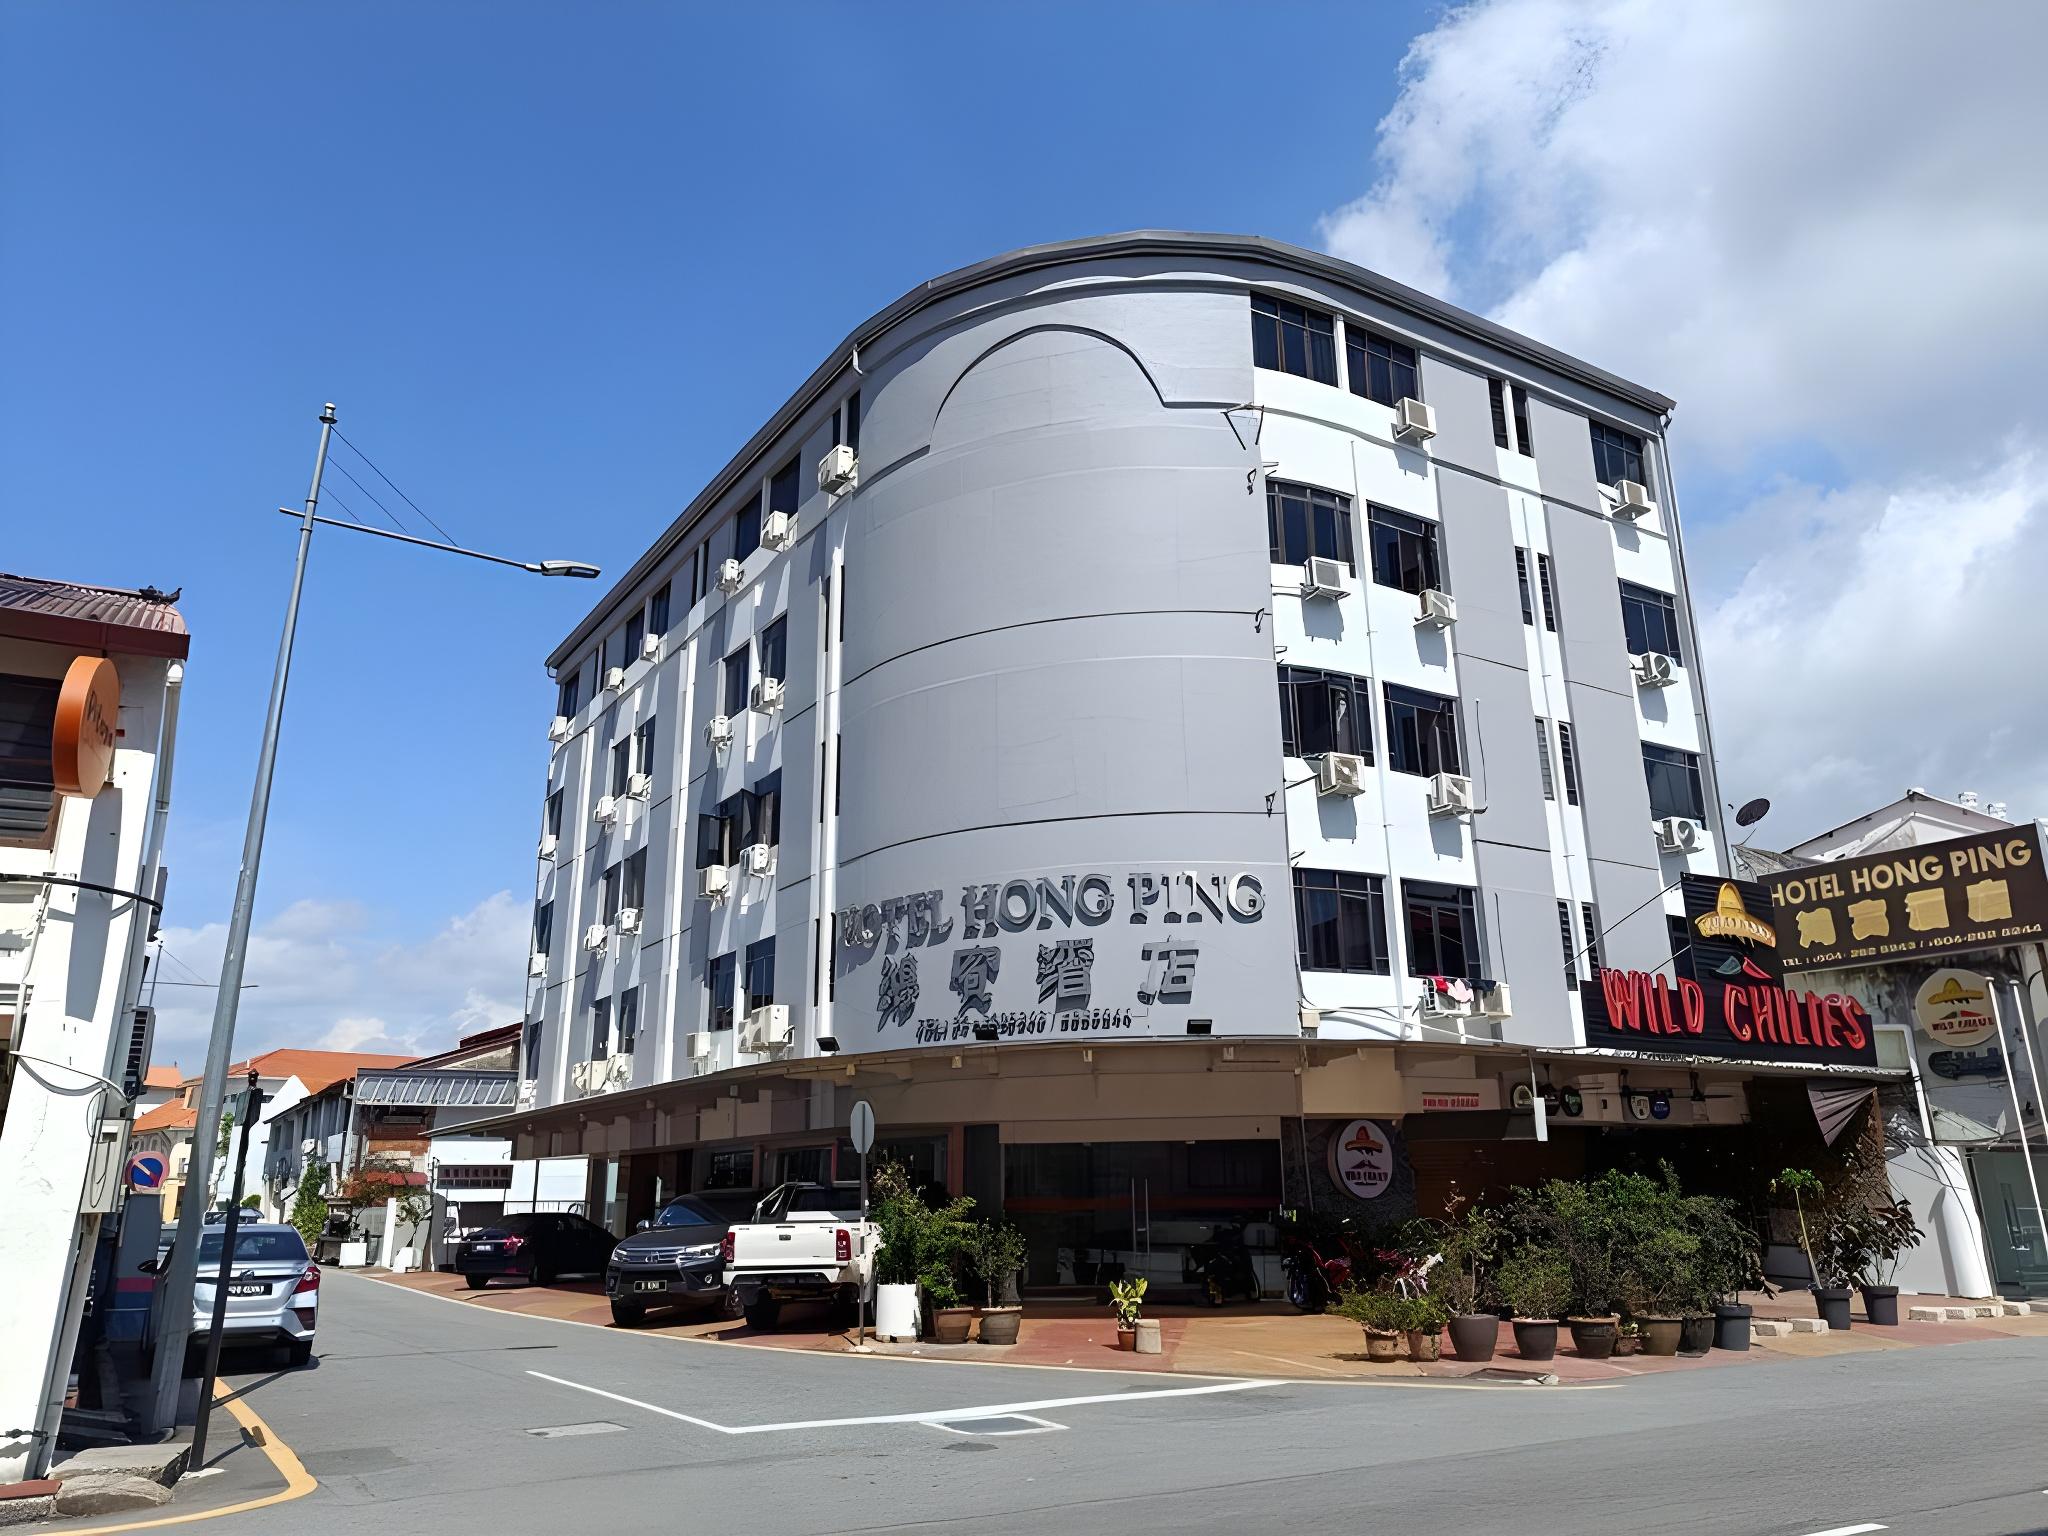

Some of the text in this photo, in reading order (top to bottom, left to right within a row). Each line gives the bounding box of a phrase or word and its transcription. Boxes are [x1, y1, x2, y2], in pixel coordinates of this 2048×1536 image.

[960, 873, 1115, 939] HONG
[1128, 871, 1266, 924] PING
[1771, 839, 2032, 907] HOTEL HONG PING
[1600, 967, 1867, 1050] WILD CHILIES
